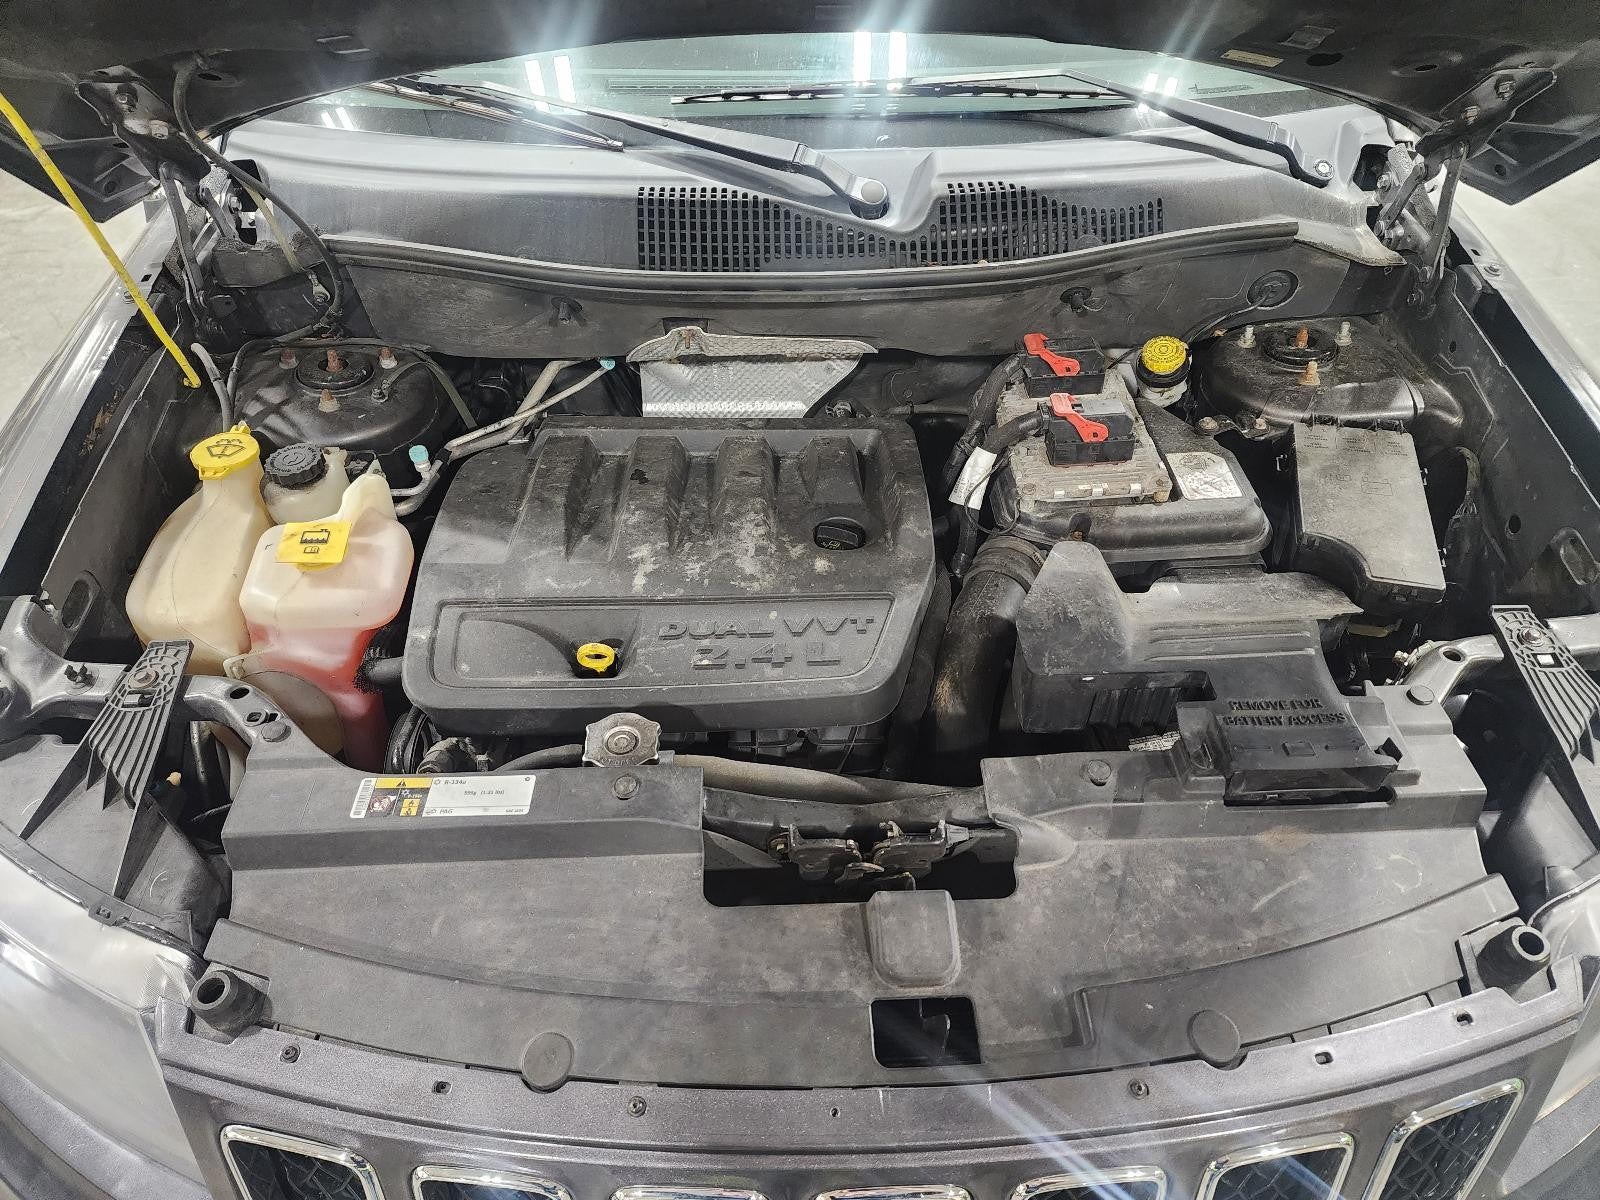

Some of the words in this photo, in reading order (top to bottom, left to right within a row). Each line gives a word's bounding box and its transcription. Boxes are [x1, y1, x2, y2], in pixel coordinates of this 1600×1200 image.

[658, 619, 774, 641] DUAL
[783, 616, 875, 636] VVT
[691, 642, 841, 671] 2.4L
[1228, 699, 1290, 711] REMOVE
[1290, 698, 1323, 710] FOR
[1223, 714, 1284, 726] BATTERY
[1288, 712, 1347, 726] ACCESS
